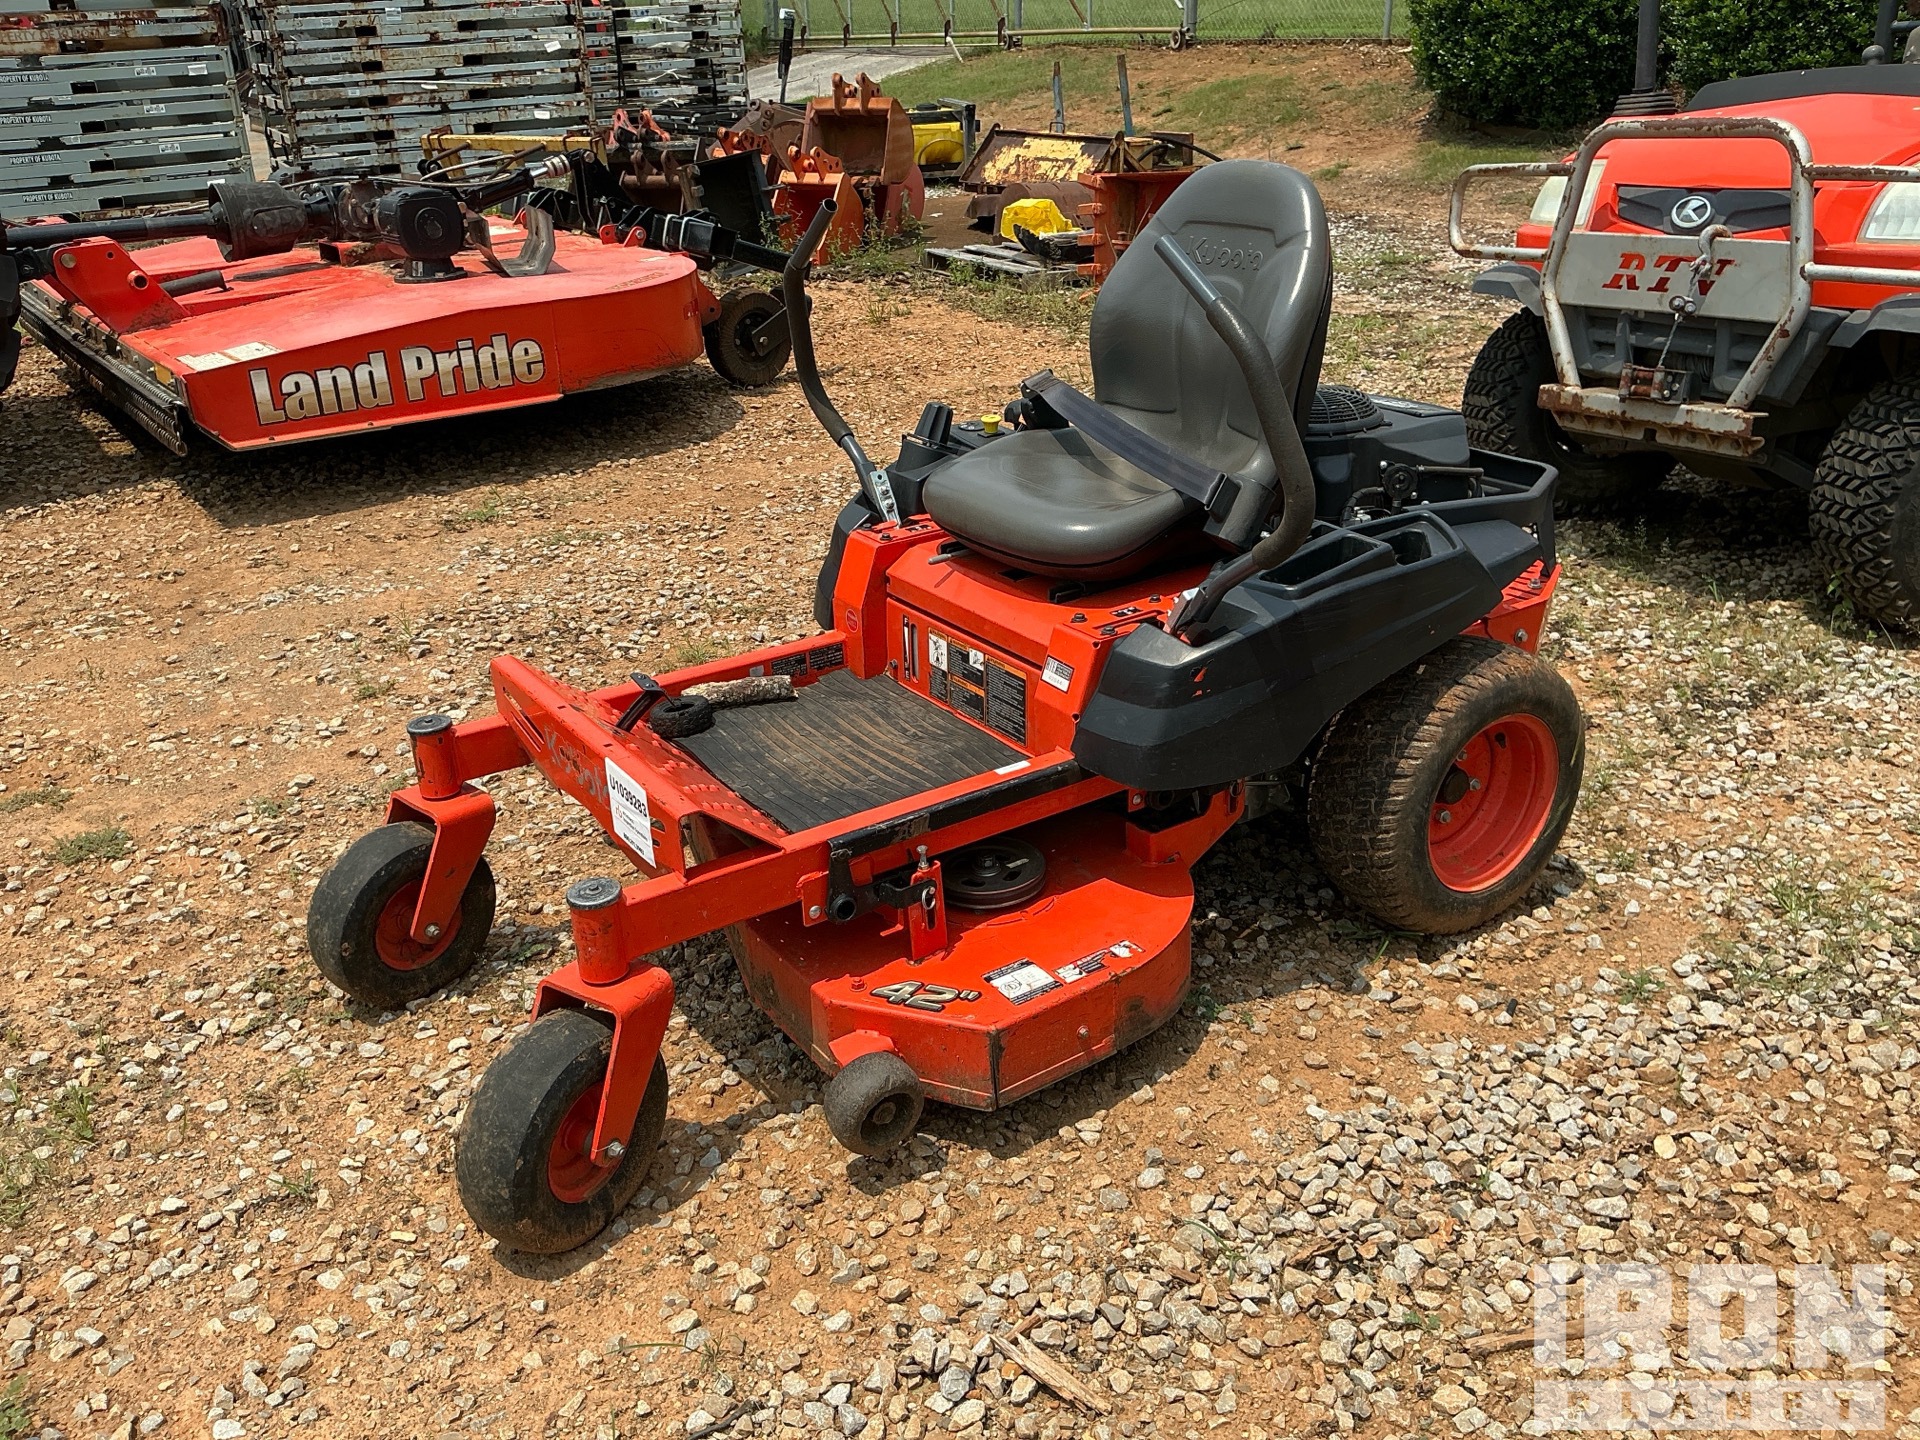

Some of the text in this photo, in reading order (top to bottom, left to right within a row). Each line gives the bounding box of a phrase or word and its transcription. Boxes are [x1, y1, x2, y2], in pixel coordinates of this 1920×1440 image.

[22, 74, 28, 82] OF
[25, 115, 31, 123] OF
[32, 115, 51, 123] KUBOTA
[10, 153, 61, 165] PROPERTY OF KUBOTA
[23, 194, 46, 203] PROPERTY
[1186, 235, 1264, 271] Kubota
[1602, 251, 1735, 296] RTV
[249, 333, 546, 426] Land Pride
[609, 774, 648, 818] U1039283
